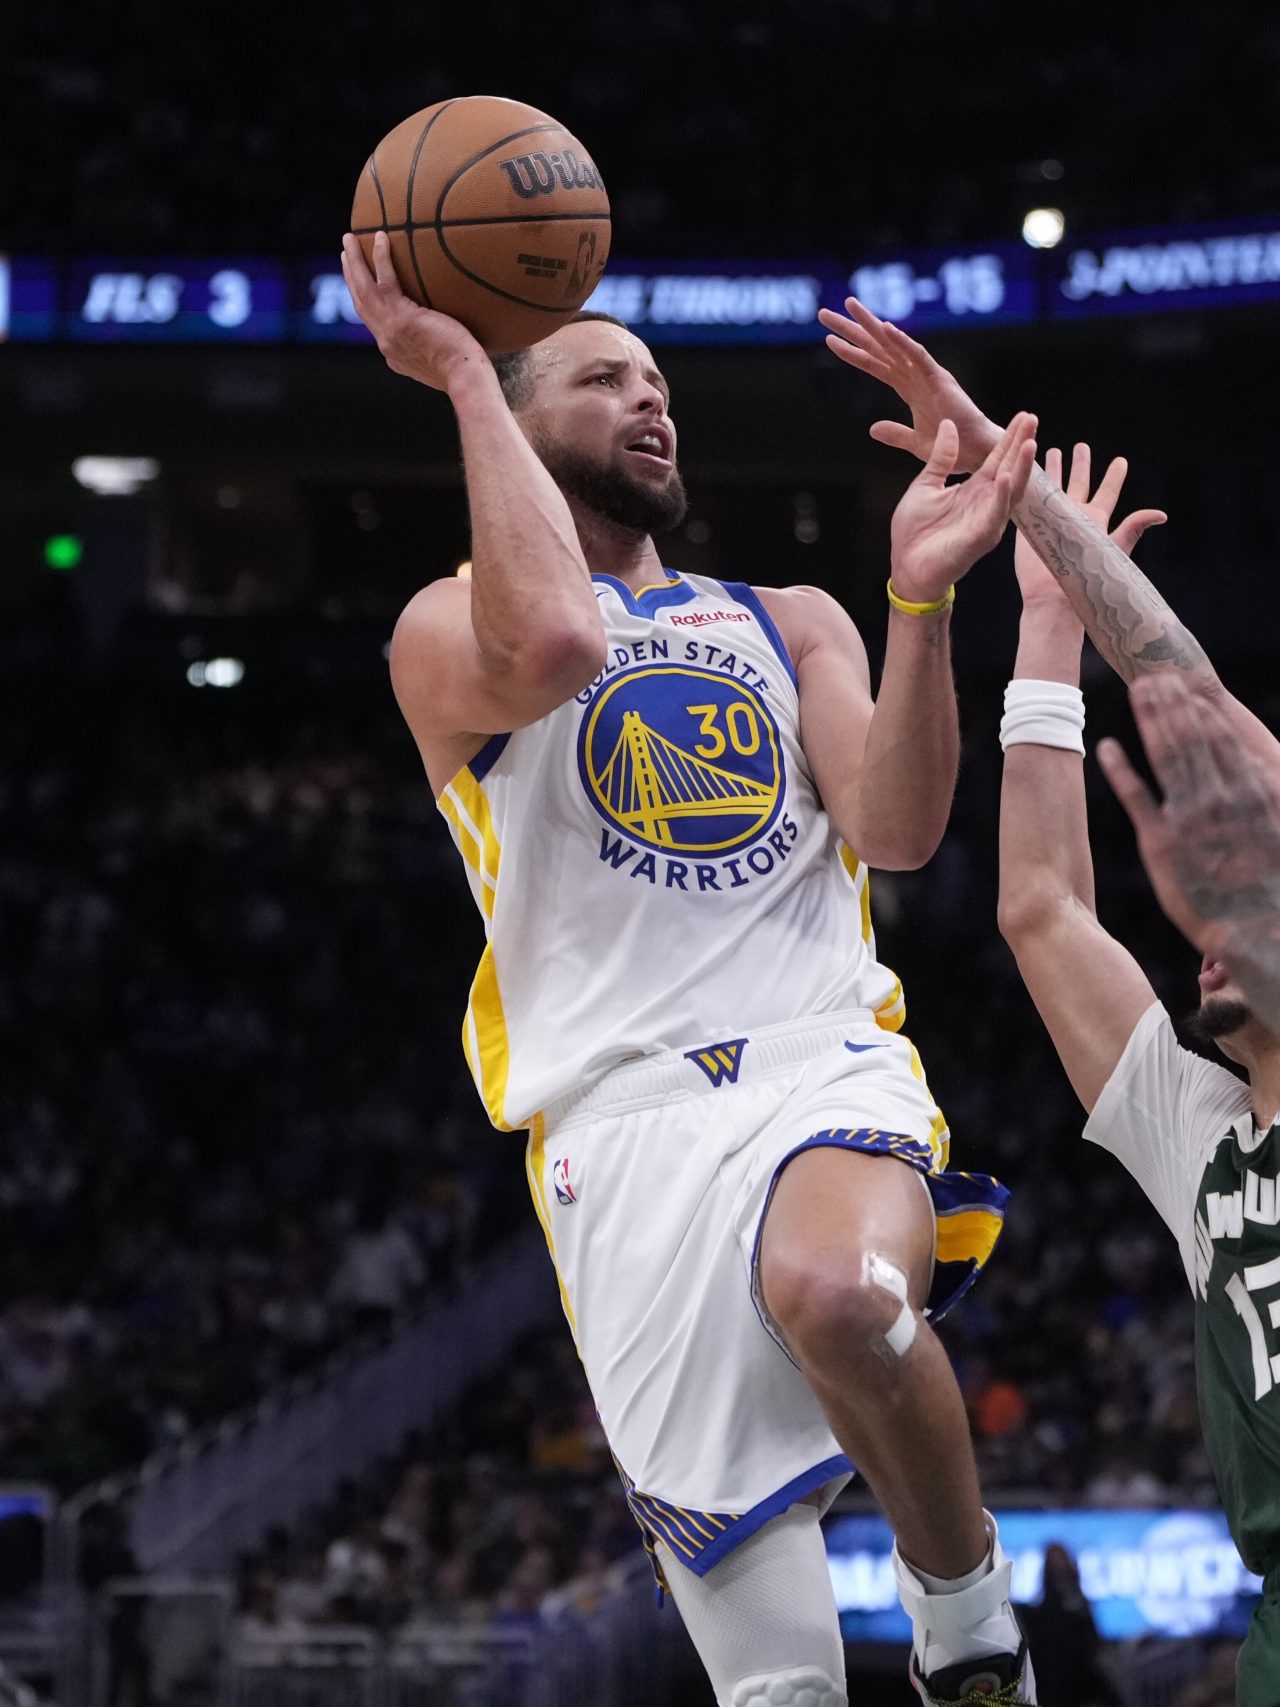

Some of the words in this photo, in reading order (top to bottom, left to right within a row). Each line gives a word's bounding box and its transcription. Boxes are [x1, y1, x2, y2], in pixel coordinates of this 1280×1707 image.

[208, 269, 252, 328] 3
[670, 609, 750, 628] Rakuten
[684, 641, 770, 693] STATE
[686, 701, 761, 759] 30
[598, 812, 798, 891] WARRIORS
